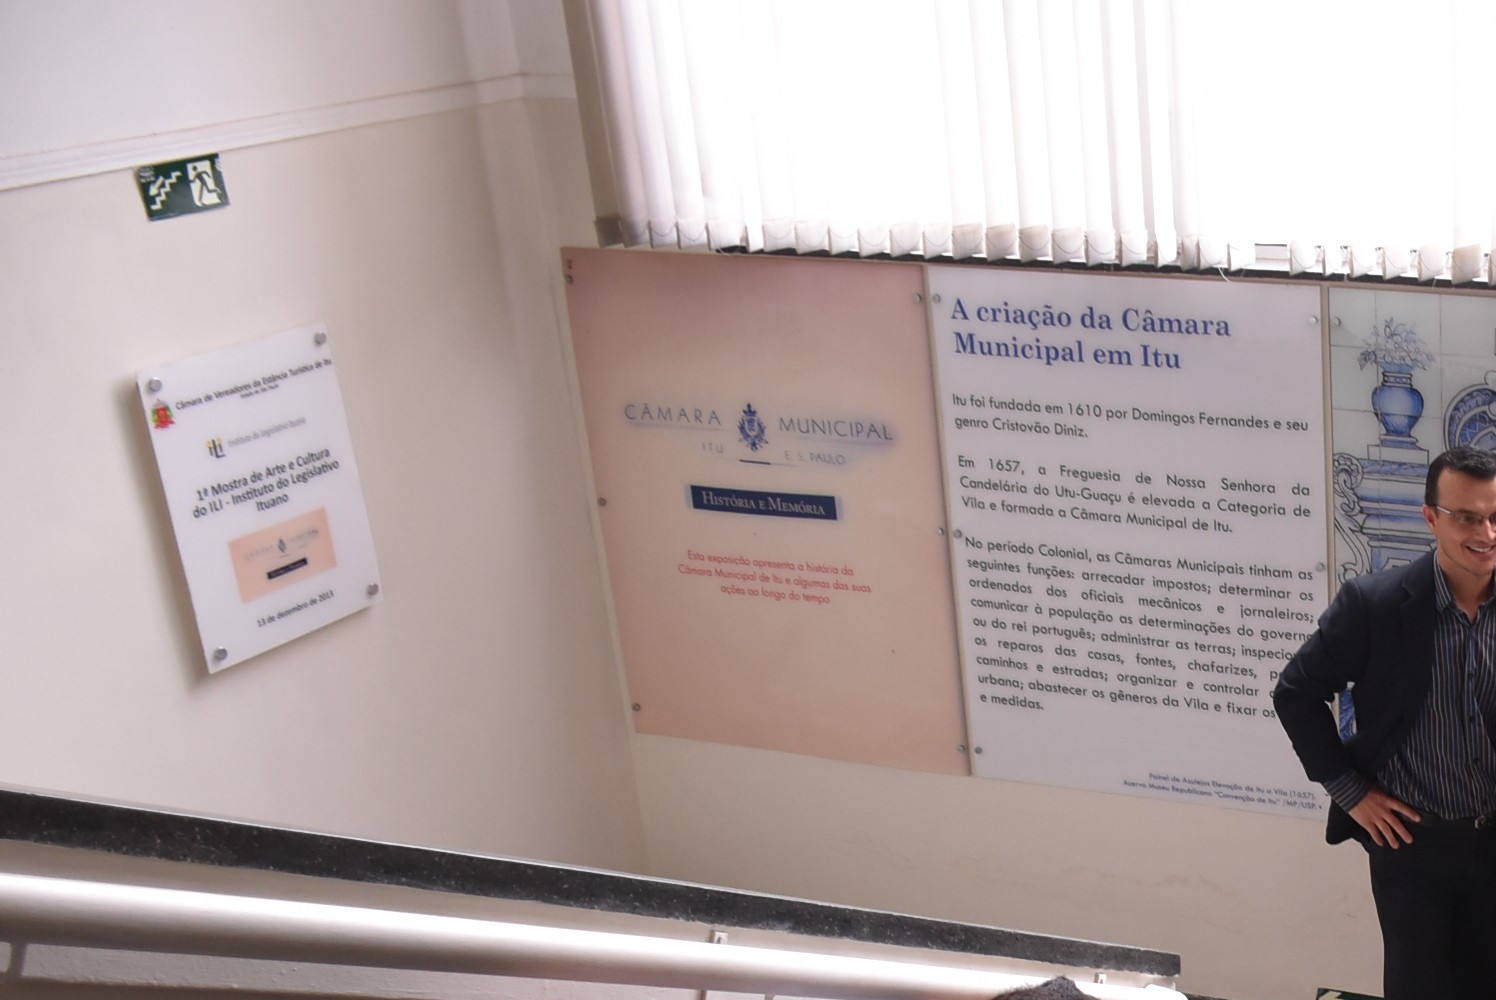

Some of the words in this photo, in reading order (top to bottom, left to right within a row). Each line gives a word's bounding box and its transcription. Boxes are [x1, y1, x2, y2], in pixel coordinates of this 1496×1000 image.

[950, 296, 970, 320] A
[975, 300, 1072, 330] criação
[1079, 305, 1113, 330] da
[1121, 307, 1231, 337] Câmara
[952, 330, 1085, 366] Municipal
[1092, 347, 1133, 366] em
[1139, 343, 1181, 369] Itu
[623, 402, 721, 426] CÂMARA
[778, 416, 893, 441] MUNICIPAL
[951, 392, 967, 406] Itu
[968, 393, 985, 408] foi
[988, 395, 1041, 413] fundada
[1044, 404, 1063, 414] em
[1067, 402, 1102, 418] 1610
[1105, 408, 1128, 421] por
[1131, 406, 1195, 426] Domingos
[1198, 411, 1269, 429] Fernandes
[1272, 419, 1282, 430] e
[1285, 420, 1308, 431] seu
[953, 416, 989, 430] genro
[991, 416, 1050, 434] Cristovão
[1053, 422, 1088, 438] Diniz.
[191, 505, 208, 519] do
[231, 483, 274, 505] Instituto
[275, 477, 289, 489] do
[290, 459, 340, 484] Legislativo
[209, 476, 248, 496] Mostra
[249, 470, 263, 483] de
[265, 463, 286, 478] Arte
[287, 460, 294, 470] e
[295, 448, 330, 467] Cultura
[957, 454, 975, 468] Em
[988, 457, 1024, 475] 1657,
[1037, 465, 1046, 475] a
[1059, 463, 1121, 482] Freguesia
[1134, 470, 1152, 485] de
[1165, 473, 1206, 489] Nossa
[1220, 476, 1276, 494] Senhora
[1290, 481, 1310, 496] da
[255, 493, 289, 512] Ituano
[959, 474, 1028, 494] Candelária
[1032, 482, 1050, 496] do
[1054, 484, 1121, 505] Utu-Guaçu
[1126, 491, 1136, 504] é
[1141, 492, 1195, 509] elevada
[1201, 500, 1210, 510] a
[1216, 497, 1286, 517] Categoria
[1292, 503, 1311, 517] de
[960, 495, 985, 509] Vila
[988, 501, 997, 511] e
[1000, 499, 1054, 516] formada
[1057, 508, 1066, 518] a
[1069, 506, 1121, 523] Câmara
[1125, 511, 1187, 531] Municipal
[1191, 517, 1209, 531] de
[1213, 518, 1233, 533] Itu.
[686, 548, 705, 561] Esta
[706, 554, 751, 566] exposição
[751, 559, 796, 570] apresenta
[805, 561, 839, 574] história
[840, 566, 854, 576] da
[965, 533, 983, 549] No
[1037, 543, 1092, 563] Colonial,
[1095, 552, 1111, 562] as
[1113, 550, 1172, 569] Câmaras
[1176, 557, 1244, 576] Municipais
[1248, 563, 1293, 579] tinham
[1297, 570, 1313, 581] as
[677, 563, 713, 577] Câmara
[713, 568, 757, 581] Municipal
[758, 572, 770, 582] de
[771, 573, 783, 584] Itu
[792, 576, 831, 589] algumas
[831, 579, 849, 591] das
[850, 583, 872, 593] suas
[719, 584, 746, 595] ações
[746, 587, 760, 596] ao
[760, 586, 786, 601] longo
[787, 589, 801, 601] do
[801, 592, 831, 605] tempo
[966, 558, 1020, 573] seguintes
[1026, 561, 1075, 579] funções:
[1081, 571, 1145, 586] arrecadar
[1151, 575, 1211, 595] impostos;
[1218, 581, 1291, 599] determinar
[1298, 591, 1313, 601] os
[968, 577, 1032, 594] ordenados
[1045, 584, 1067, 598] dos
[1080, 588, 1124, 604] oficiais
[1137, 596, 1202, 612] mecânicos
[1216, 604, 1225, 614] e
[1239, 603, 1314, 624] jornaleiros;
[969, 597, 1029, 613] comunicar
[1033, 602, 1043, 614] à
[1047, 607, 1113, 624] população
[1118, 614, 1133, 625] as
[1138, 613, 1231, 635] determinações
[1236, 623, 1254, 637] do
[972, 617, 987, 627] ou
[990, 617, 1007, 630] do
[1010, 620, 1027, 632] rei
[1031, 624, 1095, 642] português;
[1100, 630, 1170, 648] administrar
[1174, 640, 1190, 650] as
[1193, 640, 1236, 657] terras;
[1240, 644, 1295, 663] inspecio
[977, 673, 1024, 690] urbana;
[1027, 678, 1087, 696] abastecer
[1091, 689, 1105, 699] os
[1108, 689, 1158, 705] gêneros
[1161, 694, 1179, 707] da
[1183, 696, 1209, 710] Vila
[1213, 703, 1222, 712] e
[1225, 700, 1257, 716] fixar
[1261, 705, 1275, 718] os
[979, 693, 987, 702] e
[990, 695, 1044, 710] medidas.
